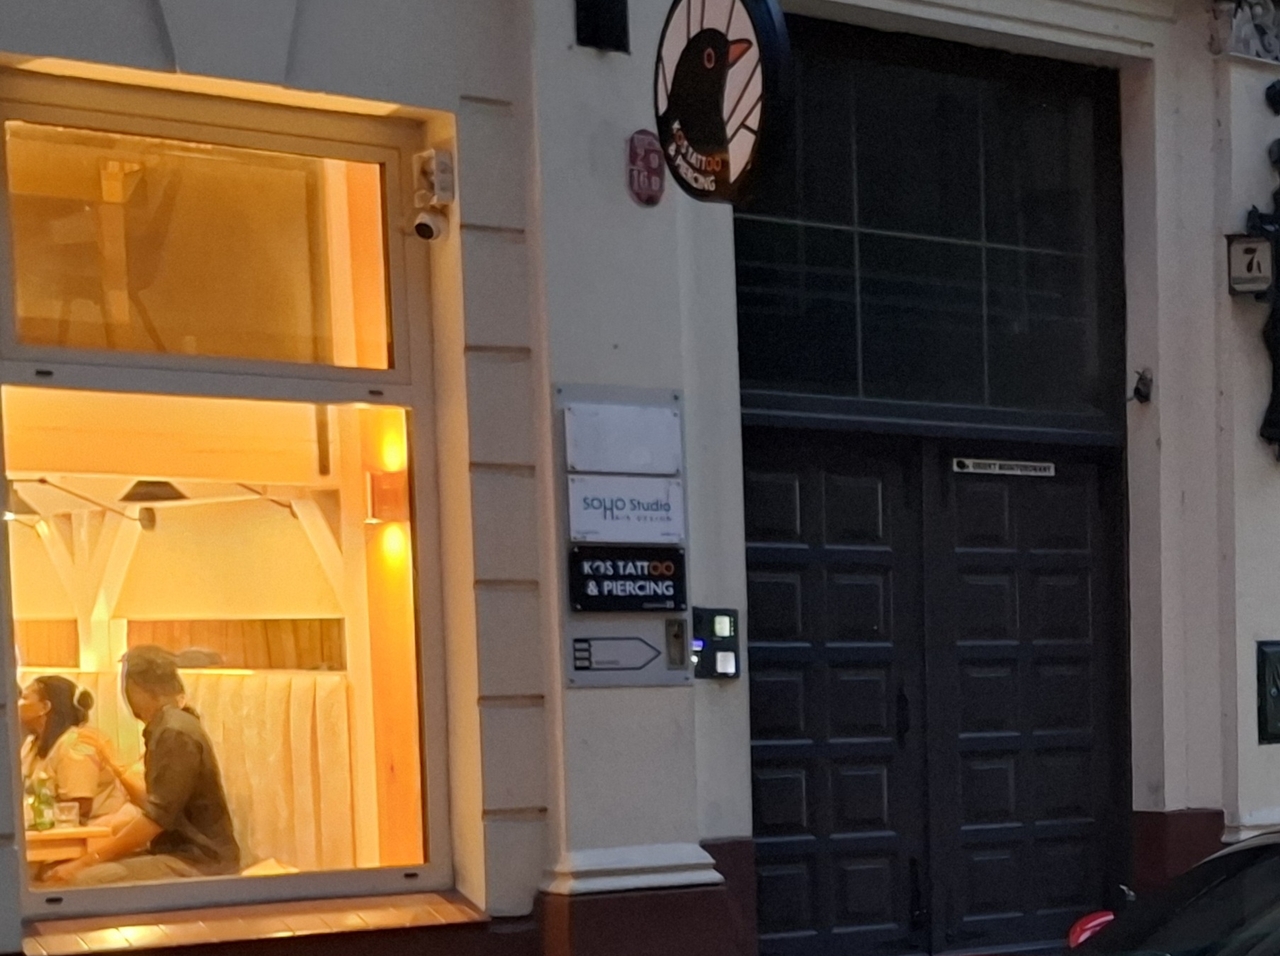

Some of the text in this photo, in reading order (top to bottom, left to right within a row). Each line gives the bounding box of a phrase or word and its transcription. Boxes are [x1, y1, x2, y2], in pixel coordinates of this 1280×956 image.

[687, 145, 722, 173] TATTOO
[675, 154, 716, 192] PIERCING
[583, 497, 671, 520] SOHO Studio
[583, 560, 675, 575] KOS TATTOO
[586, 579, 674, 596] & PIERCING
